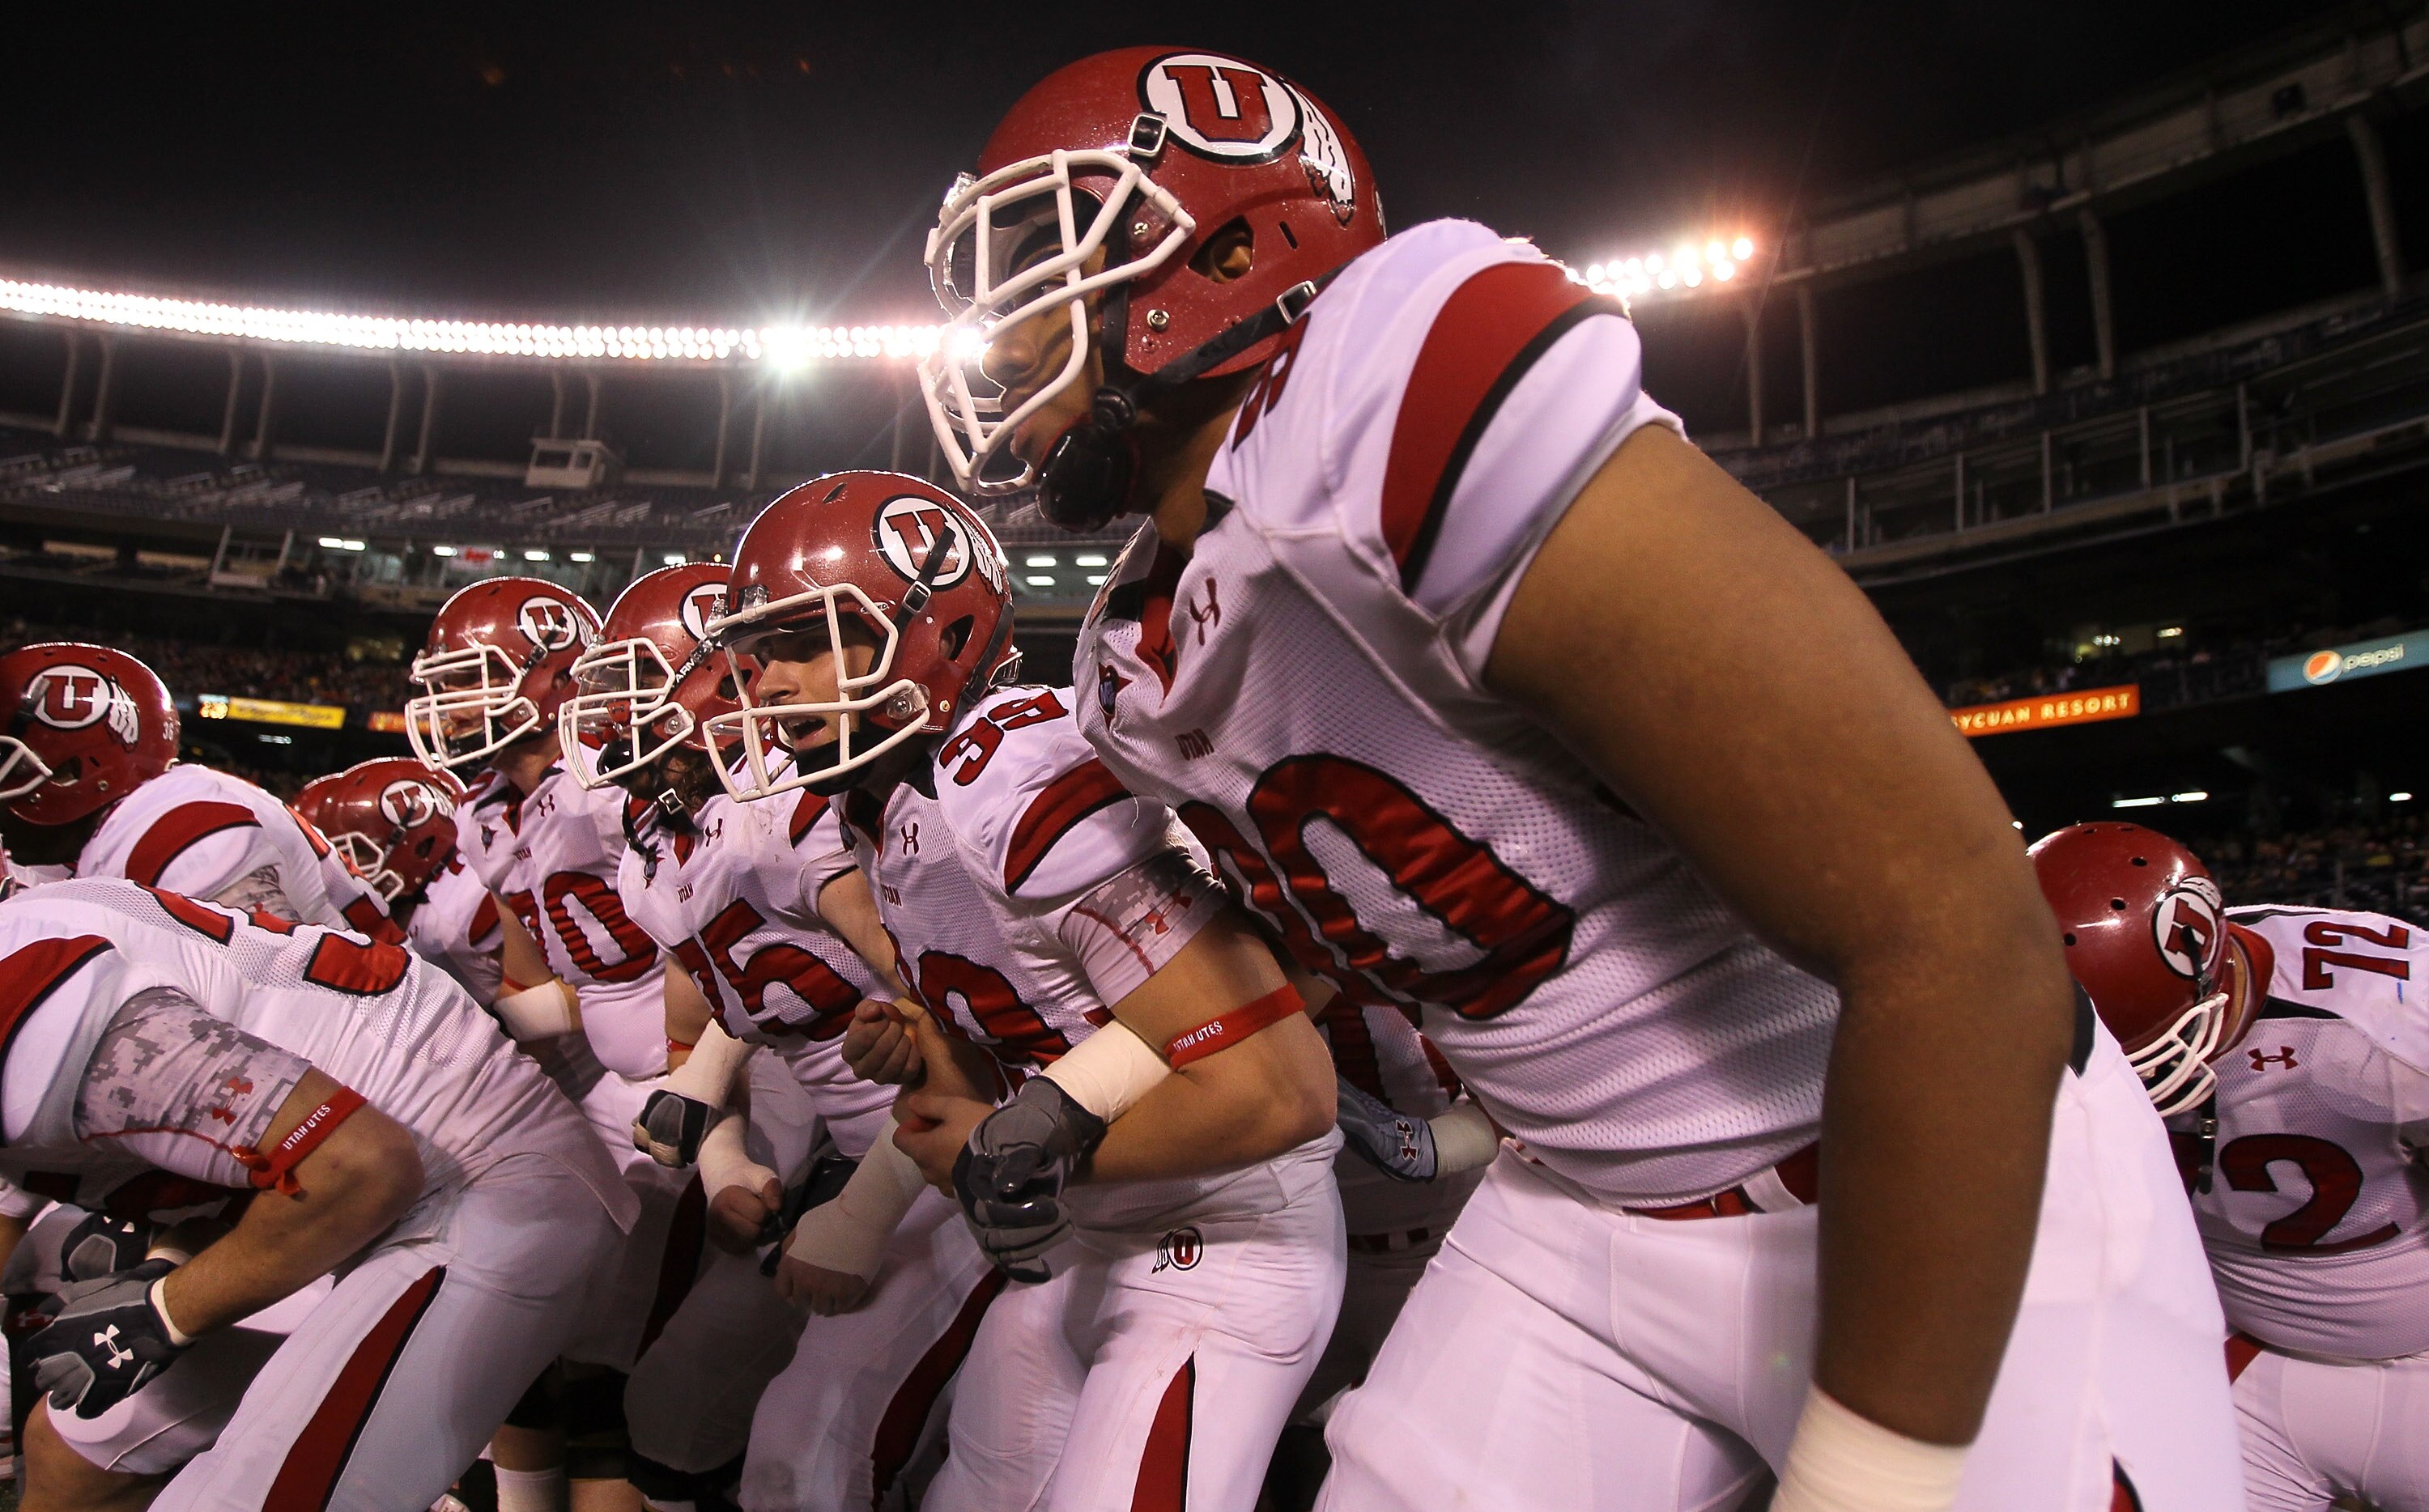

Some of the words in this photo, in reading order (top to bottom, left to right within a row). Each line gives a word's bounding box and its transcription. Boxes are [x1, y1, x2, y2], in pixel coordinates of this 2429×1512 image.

[1163, 65, 1274, 143] U
[2342, 643, 2405, 673] pepsi
[40, 674, 100, 721] U
[2040, 693, 2130, 720] RESORT
[938, 690, 1070, 787] 39
[2301, 921, 2410, 992] 72
[1172, 1034, 1196, 1052] UTAH
[1195, 1021, 1223, 1042] UTES
[282, 1125, 308, 1150] UTAH
[306, 1104, 331, 1128] UTES
[1173, 1234, 1197, 1265] U
